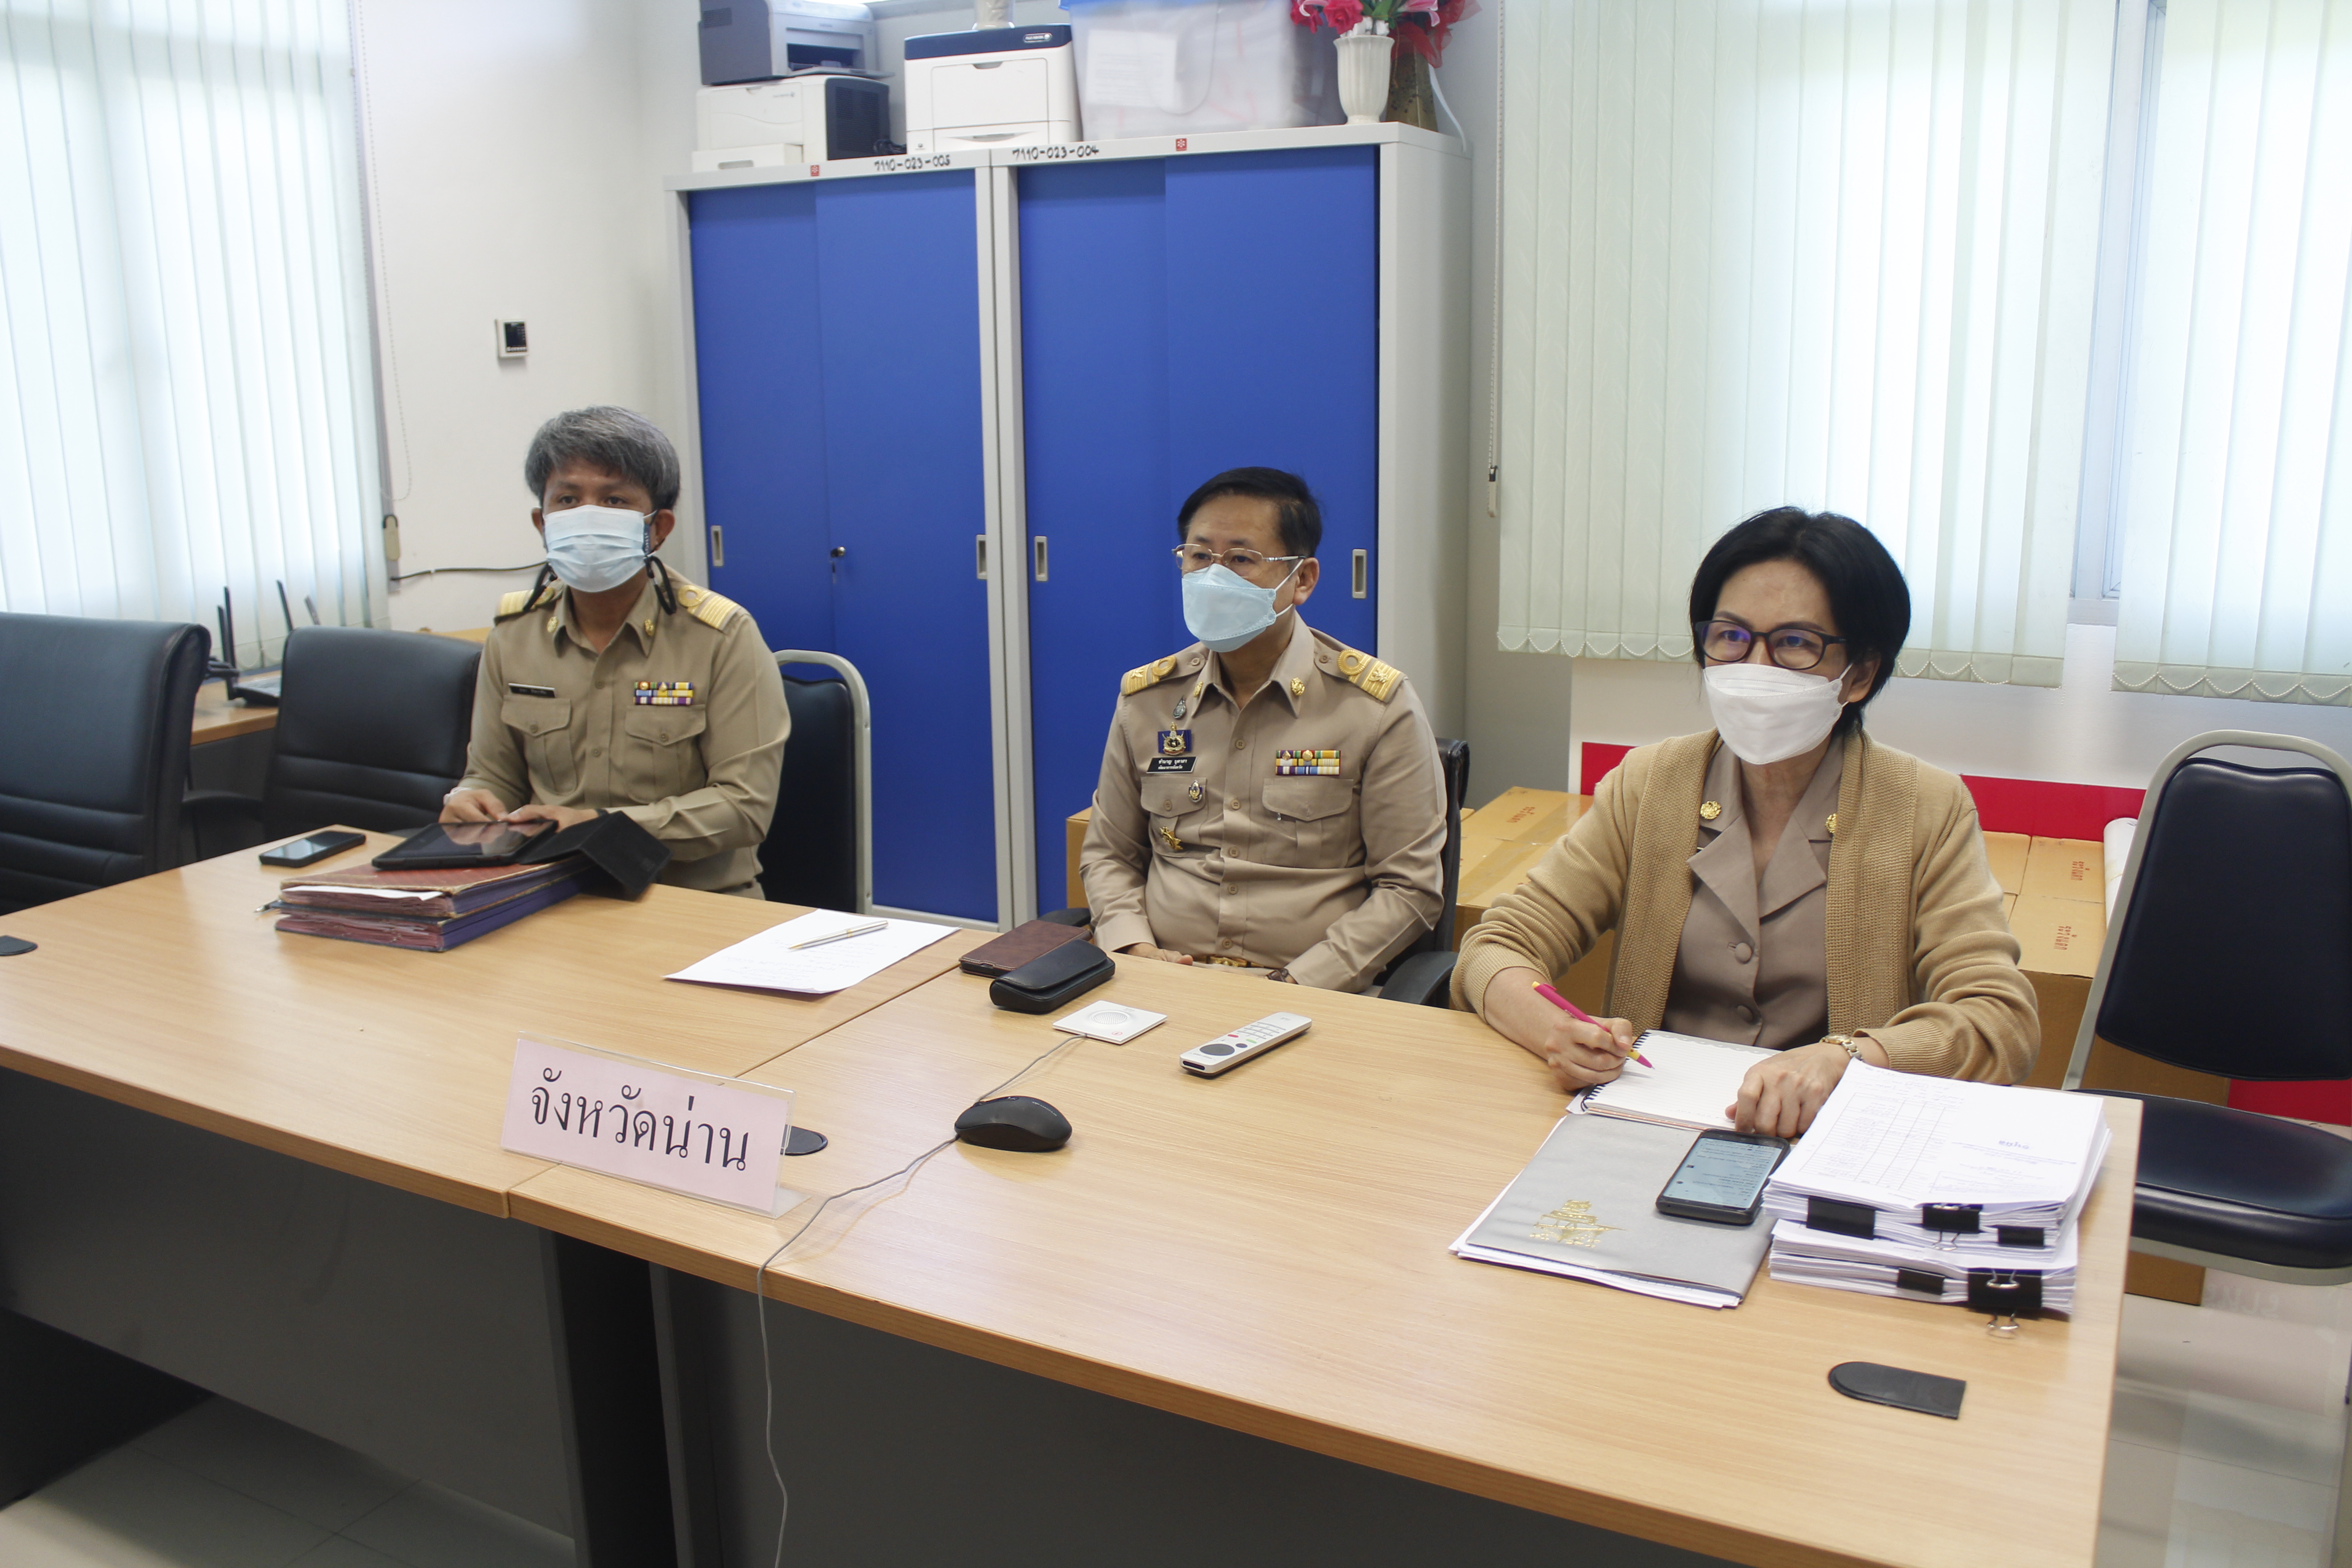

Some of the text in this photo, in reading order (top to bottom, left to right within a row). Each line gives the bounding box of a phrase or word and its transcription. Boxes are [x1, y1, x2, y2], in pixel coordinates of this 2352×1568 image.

[1012, 145, 1100, 161] 7110-023-004
[874, 154, 951, 172] 7110-023-005
[531, 1067, 749, 1171] จังหวัดน่าน
